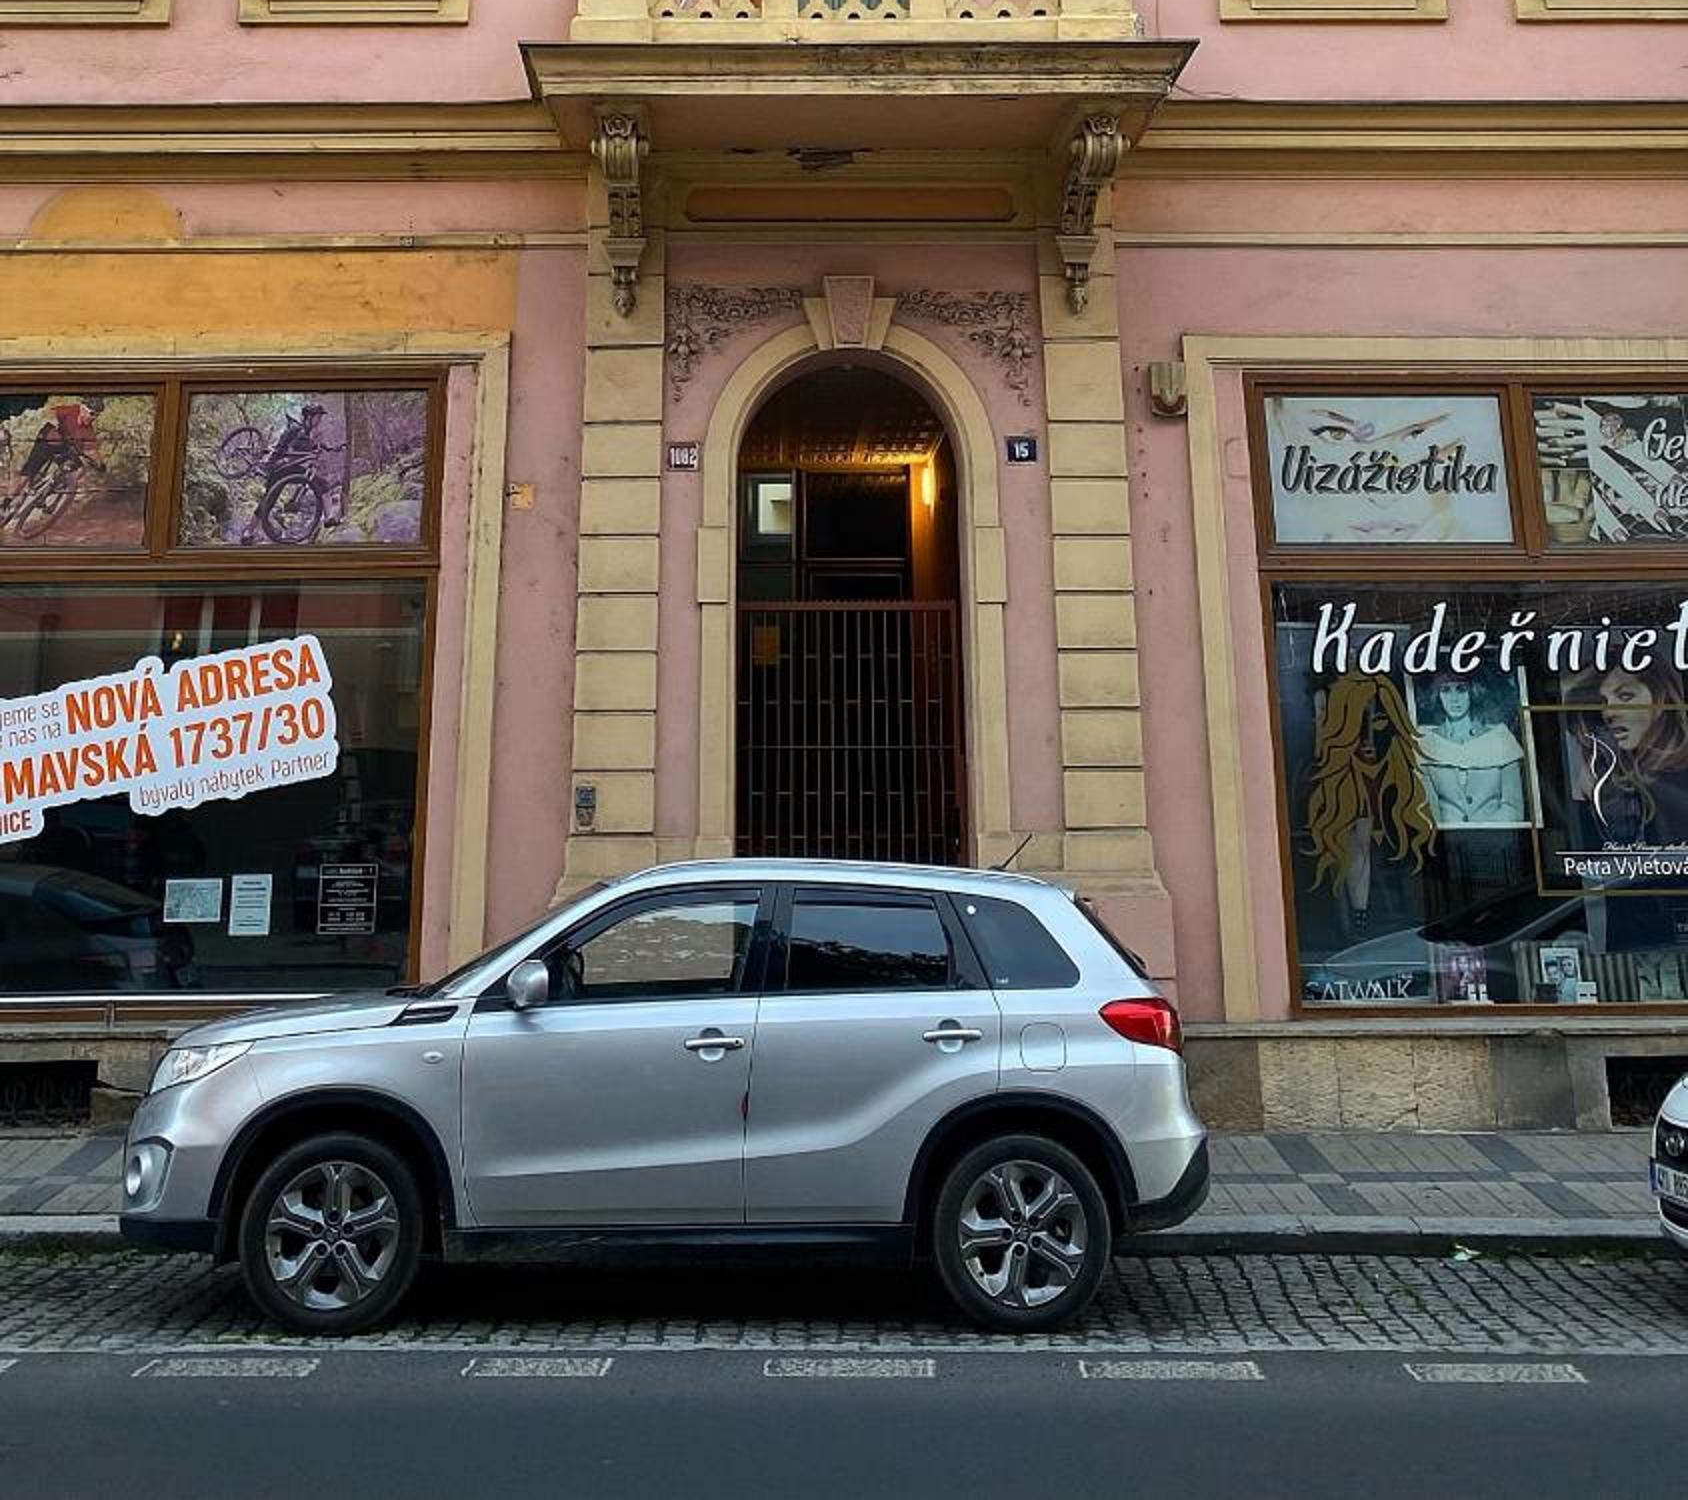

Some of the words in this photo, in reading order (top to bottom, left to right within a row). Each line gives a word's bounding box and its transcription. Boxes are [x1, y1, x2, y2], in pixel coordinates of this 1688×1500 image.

[1014, 441, 1029, 459] 15
[1281, 443, 1499, 494] Vizážistika
[65, 666, 163, 735] NOVÁ
[176, 643, 321, 712] ADRESA
[42, 701, 60, 719] se
[3, 723, 157, 805] MAVSKÁ
[169, 697, 326, 769] 1737/30
[10, 724, 37, 747] nás
[42, 721, 61, 739] na
[139, 776, 196, 808] bývalý
[201, 764, 265, 793] nábytek
[271, 751, 329, 779] Partner
[1563, 856, 1612, 876] Petra
